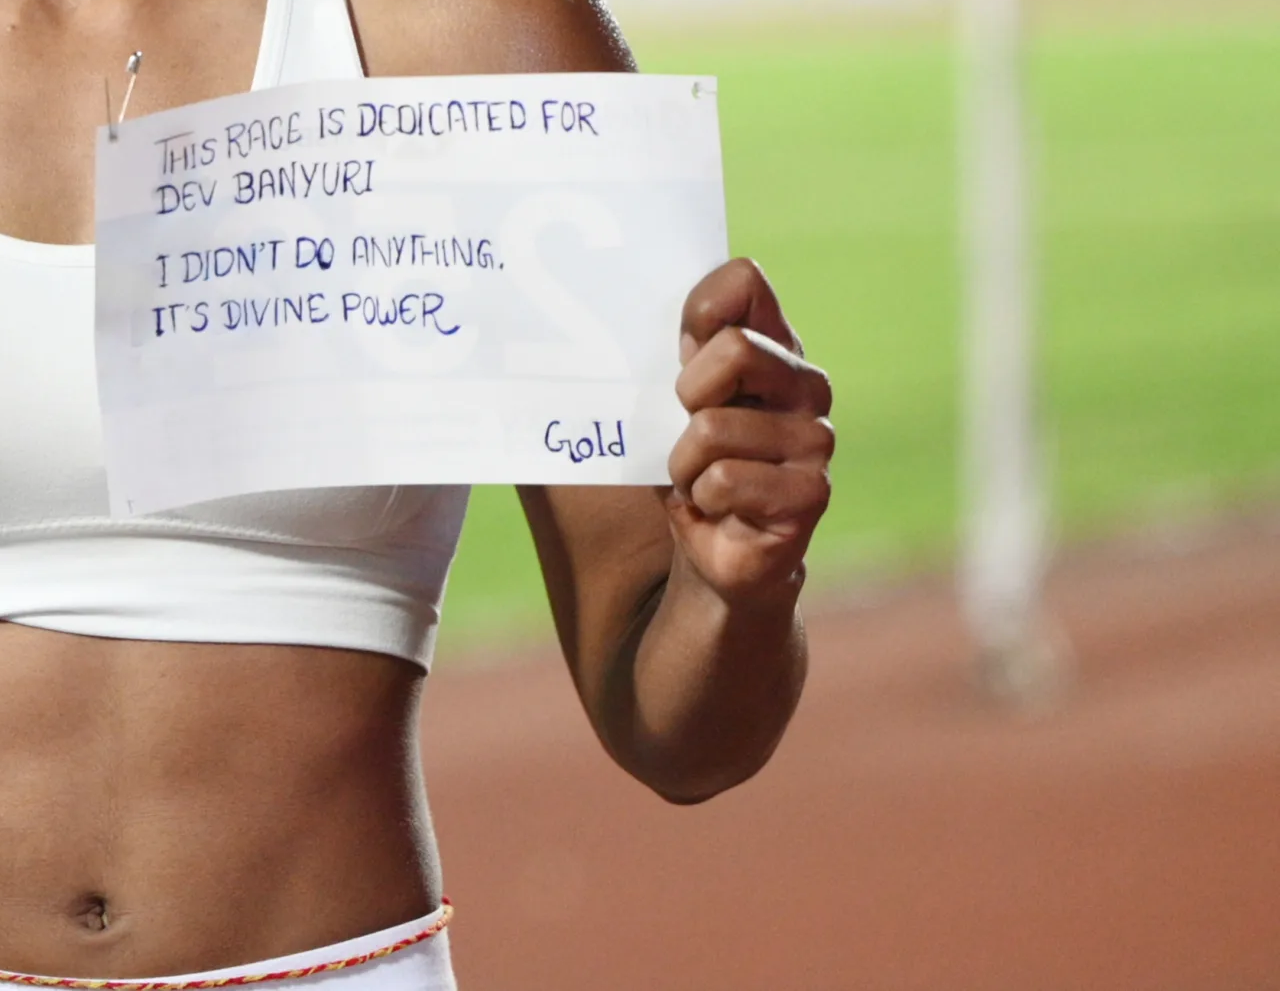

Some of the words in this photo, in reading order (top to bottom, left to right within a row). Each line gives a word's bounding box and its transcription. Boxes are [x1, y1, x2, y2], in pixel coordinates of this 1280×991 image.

[154, 130, 217, 174] THIS
[225, 112, 302, 158] RACE
[319, 107, 345, 139] IS
[357, 100, 526, 136] DEDICATED
[541, 100, 598, 135] FOR
[156, 180, 217, 215] DEV
[233, 160, 375, 204] BANYURI
[156, 254, 169, 288] I
[180, 240, 285, 283] DIDN'T
[295, 236, 335, 270] DO
[352, 234, 504, 270] ANYTHING.
[152, 301, 209, 337] IT'S
[220, 292, 330, 330] DIVINE
[341, 292, 461, 336] POWER
[544, 419, 626, 464] Gold
